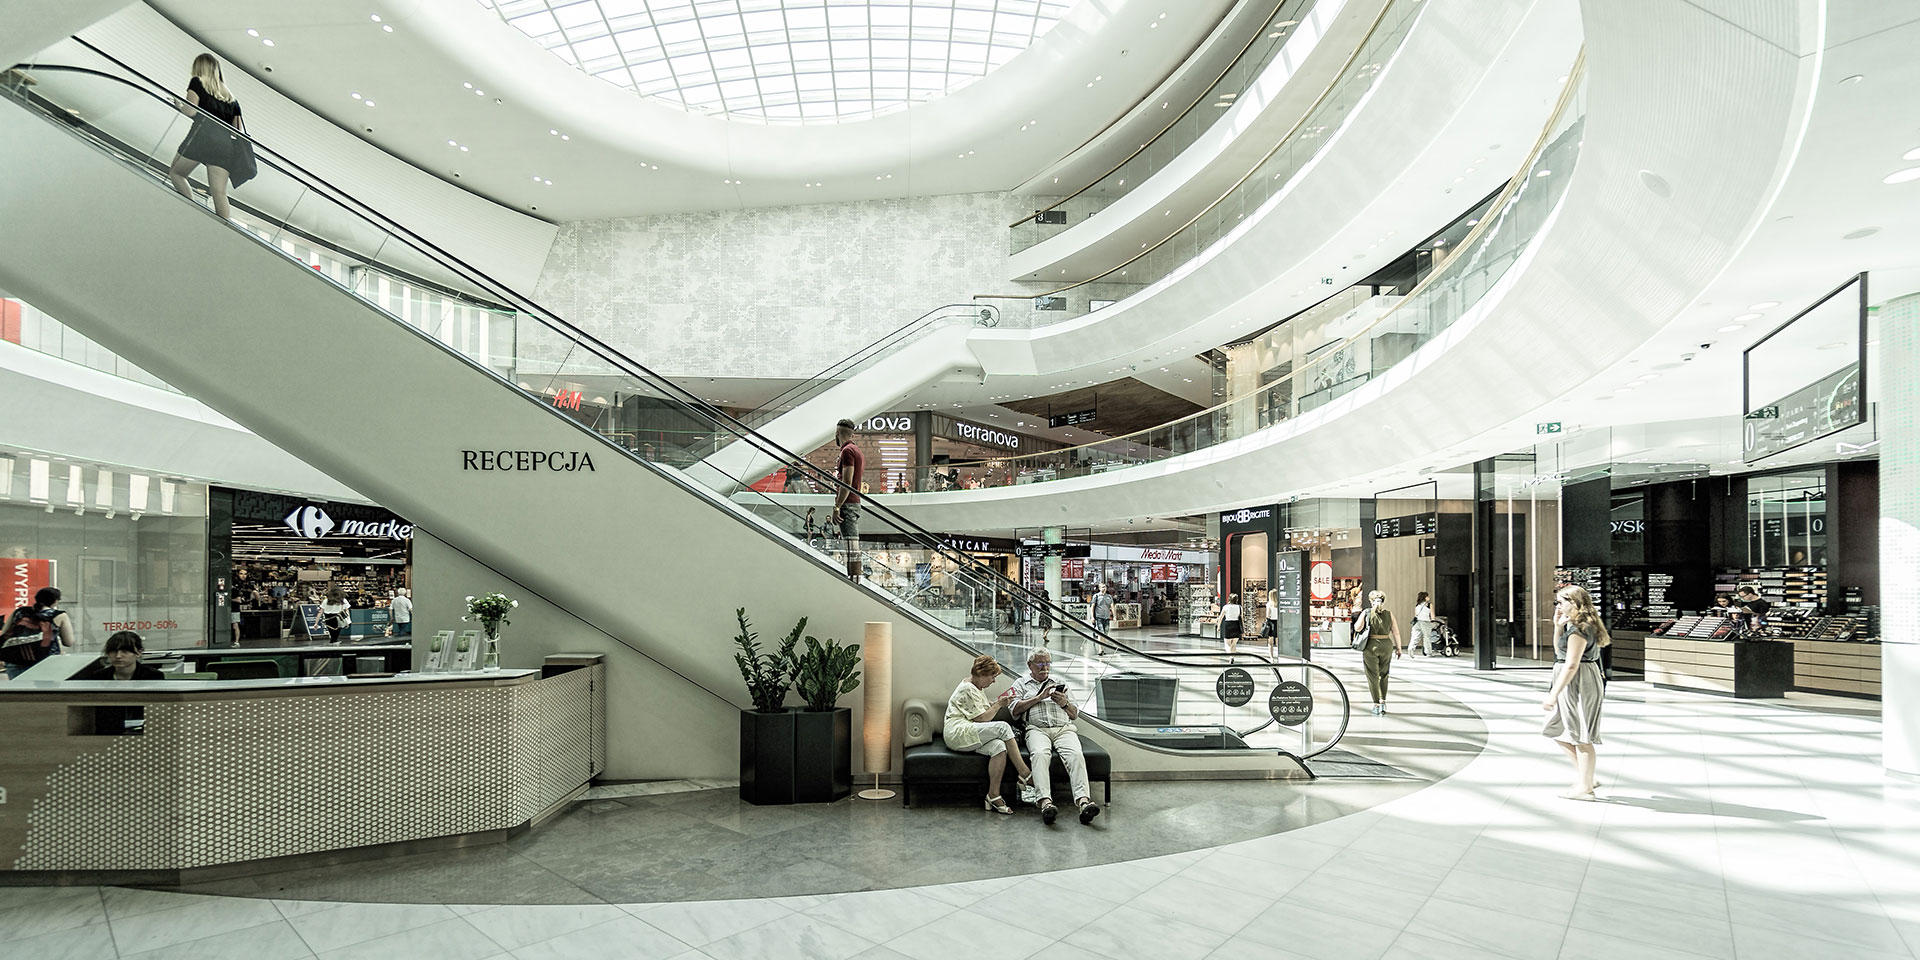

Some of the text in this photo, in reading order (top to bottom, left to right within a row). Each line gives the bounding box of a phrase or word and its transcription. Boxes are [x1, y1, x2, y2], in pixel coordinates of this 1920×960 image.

[552, 388, 583, 411] H&M
[854, 417, 911, 431] nova
[461, 450, 595, 472] RECEPCJA
[1313, 577, 1330, 585] SALE
[103, 620, 178, 631] TERAZ DO -50%
